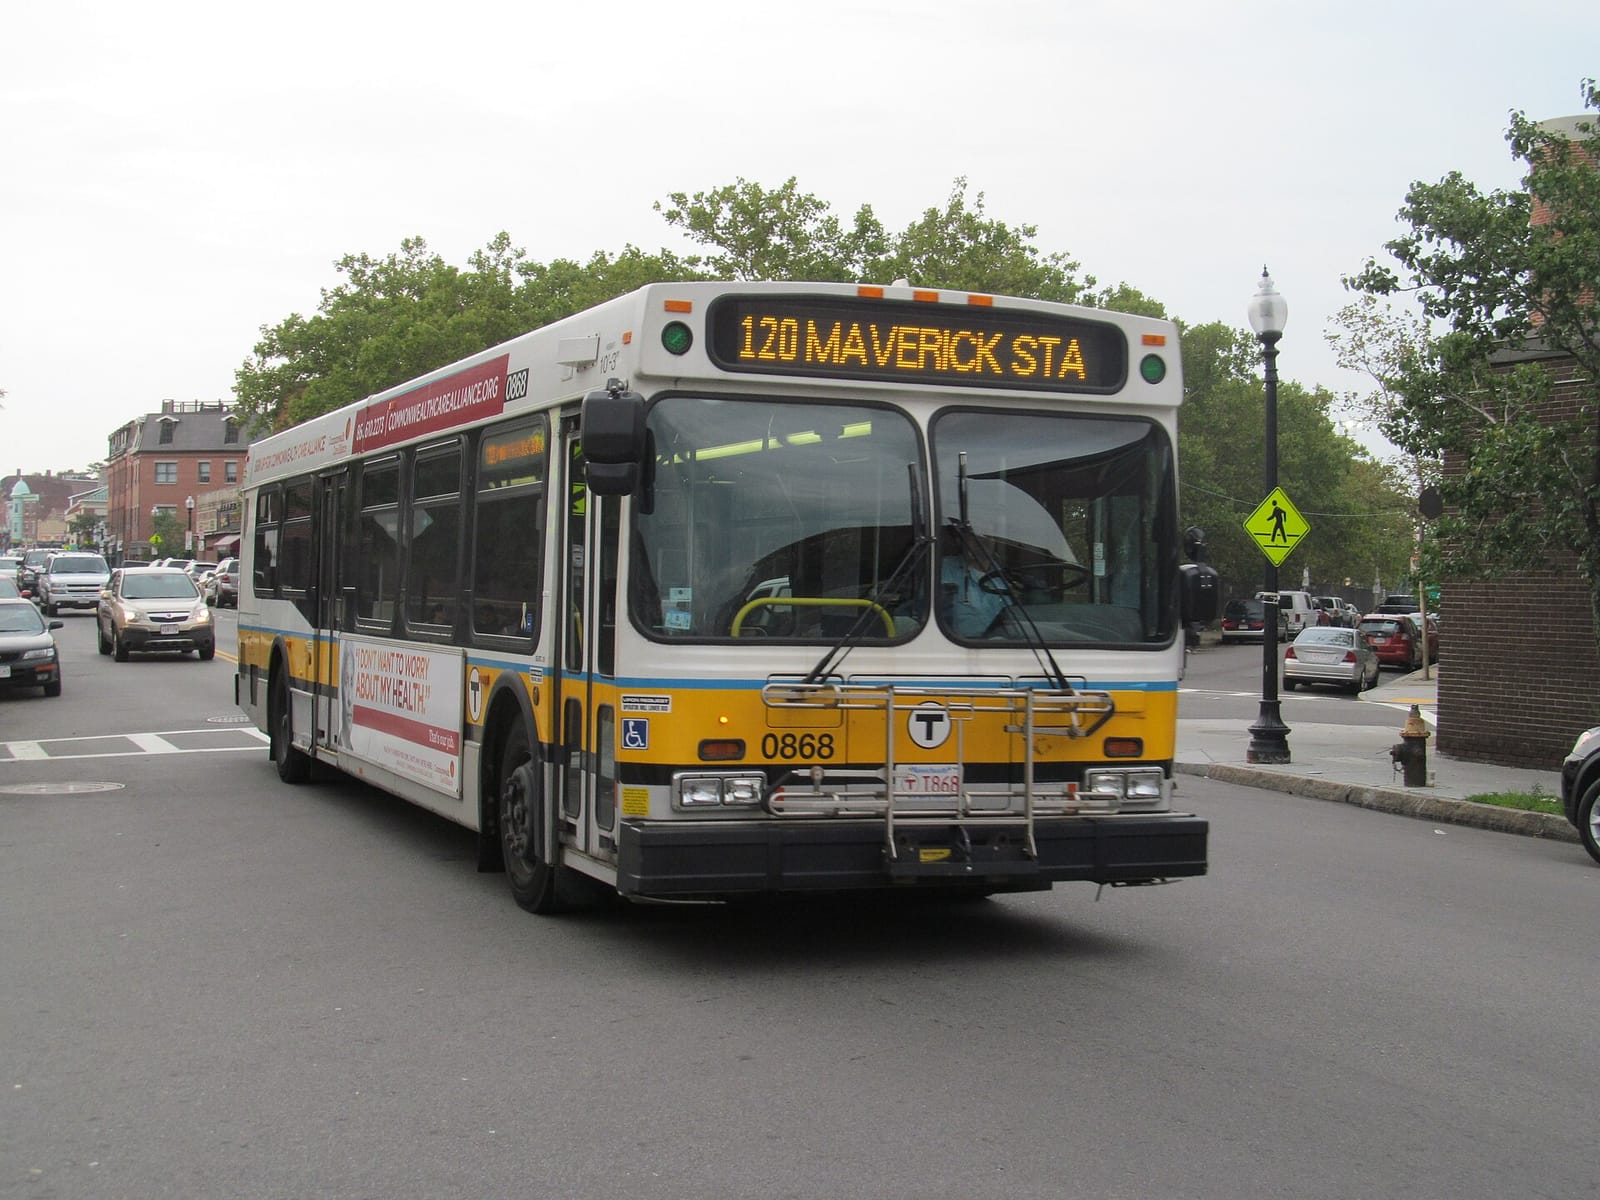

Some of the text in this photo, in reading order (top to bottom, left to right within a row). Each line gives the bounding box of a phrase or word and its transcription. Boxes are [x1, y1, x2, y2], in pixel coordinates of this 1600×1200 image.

[739, 315, 1085, 380] 120 MAVERICK STA
[506, 371, 527, 400] 0868
[388, 376, 499, 431] COMMONWEALTHCAREALLIANCE.ORG
[377, 649, 394, 673] WANT
[394, 652, 404, 675] TO
[405, 654, 431, 681] WORRY
[355, 672, 380, 702] ABOUT
[380, 676, 392, 705] MY
[470, 681, 480, 713] T
[916, 714, 944, 741] T
[761, 732, 834, 760] 0868
